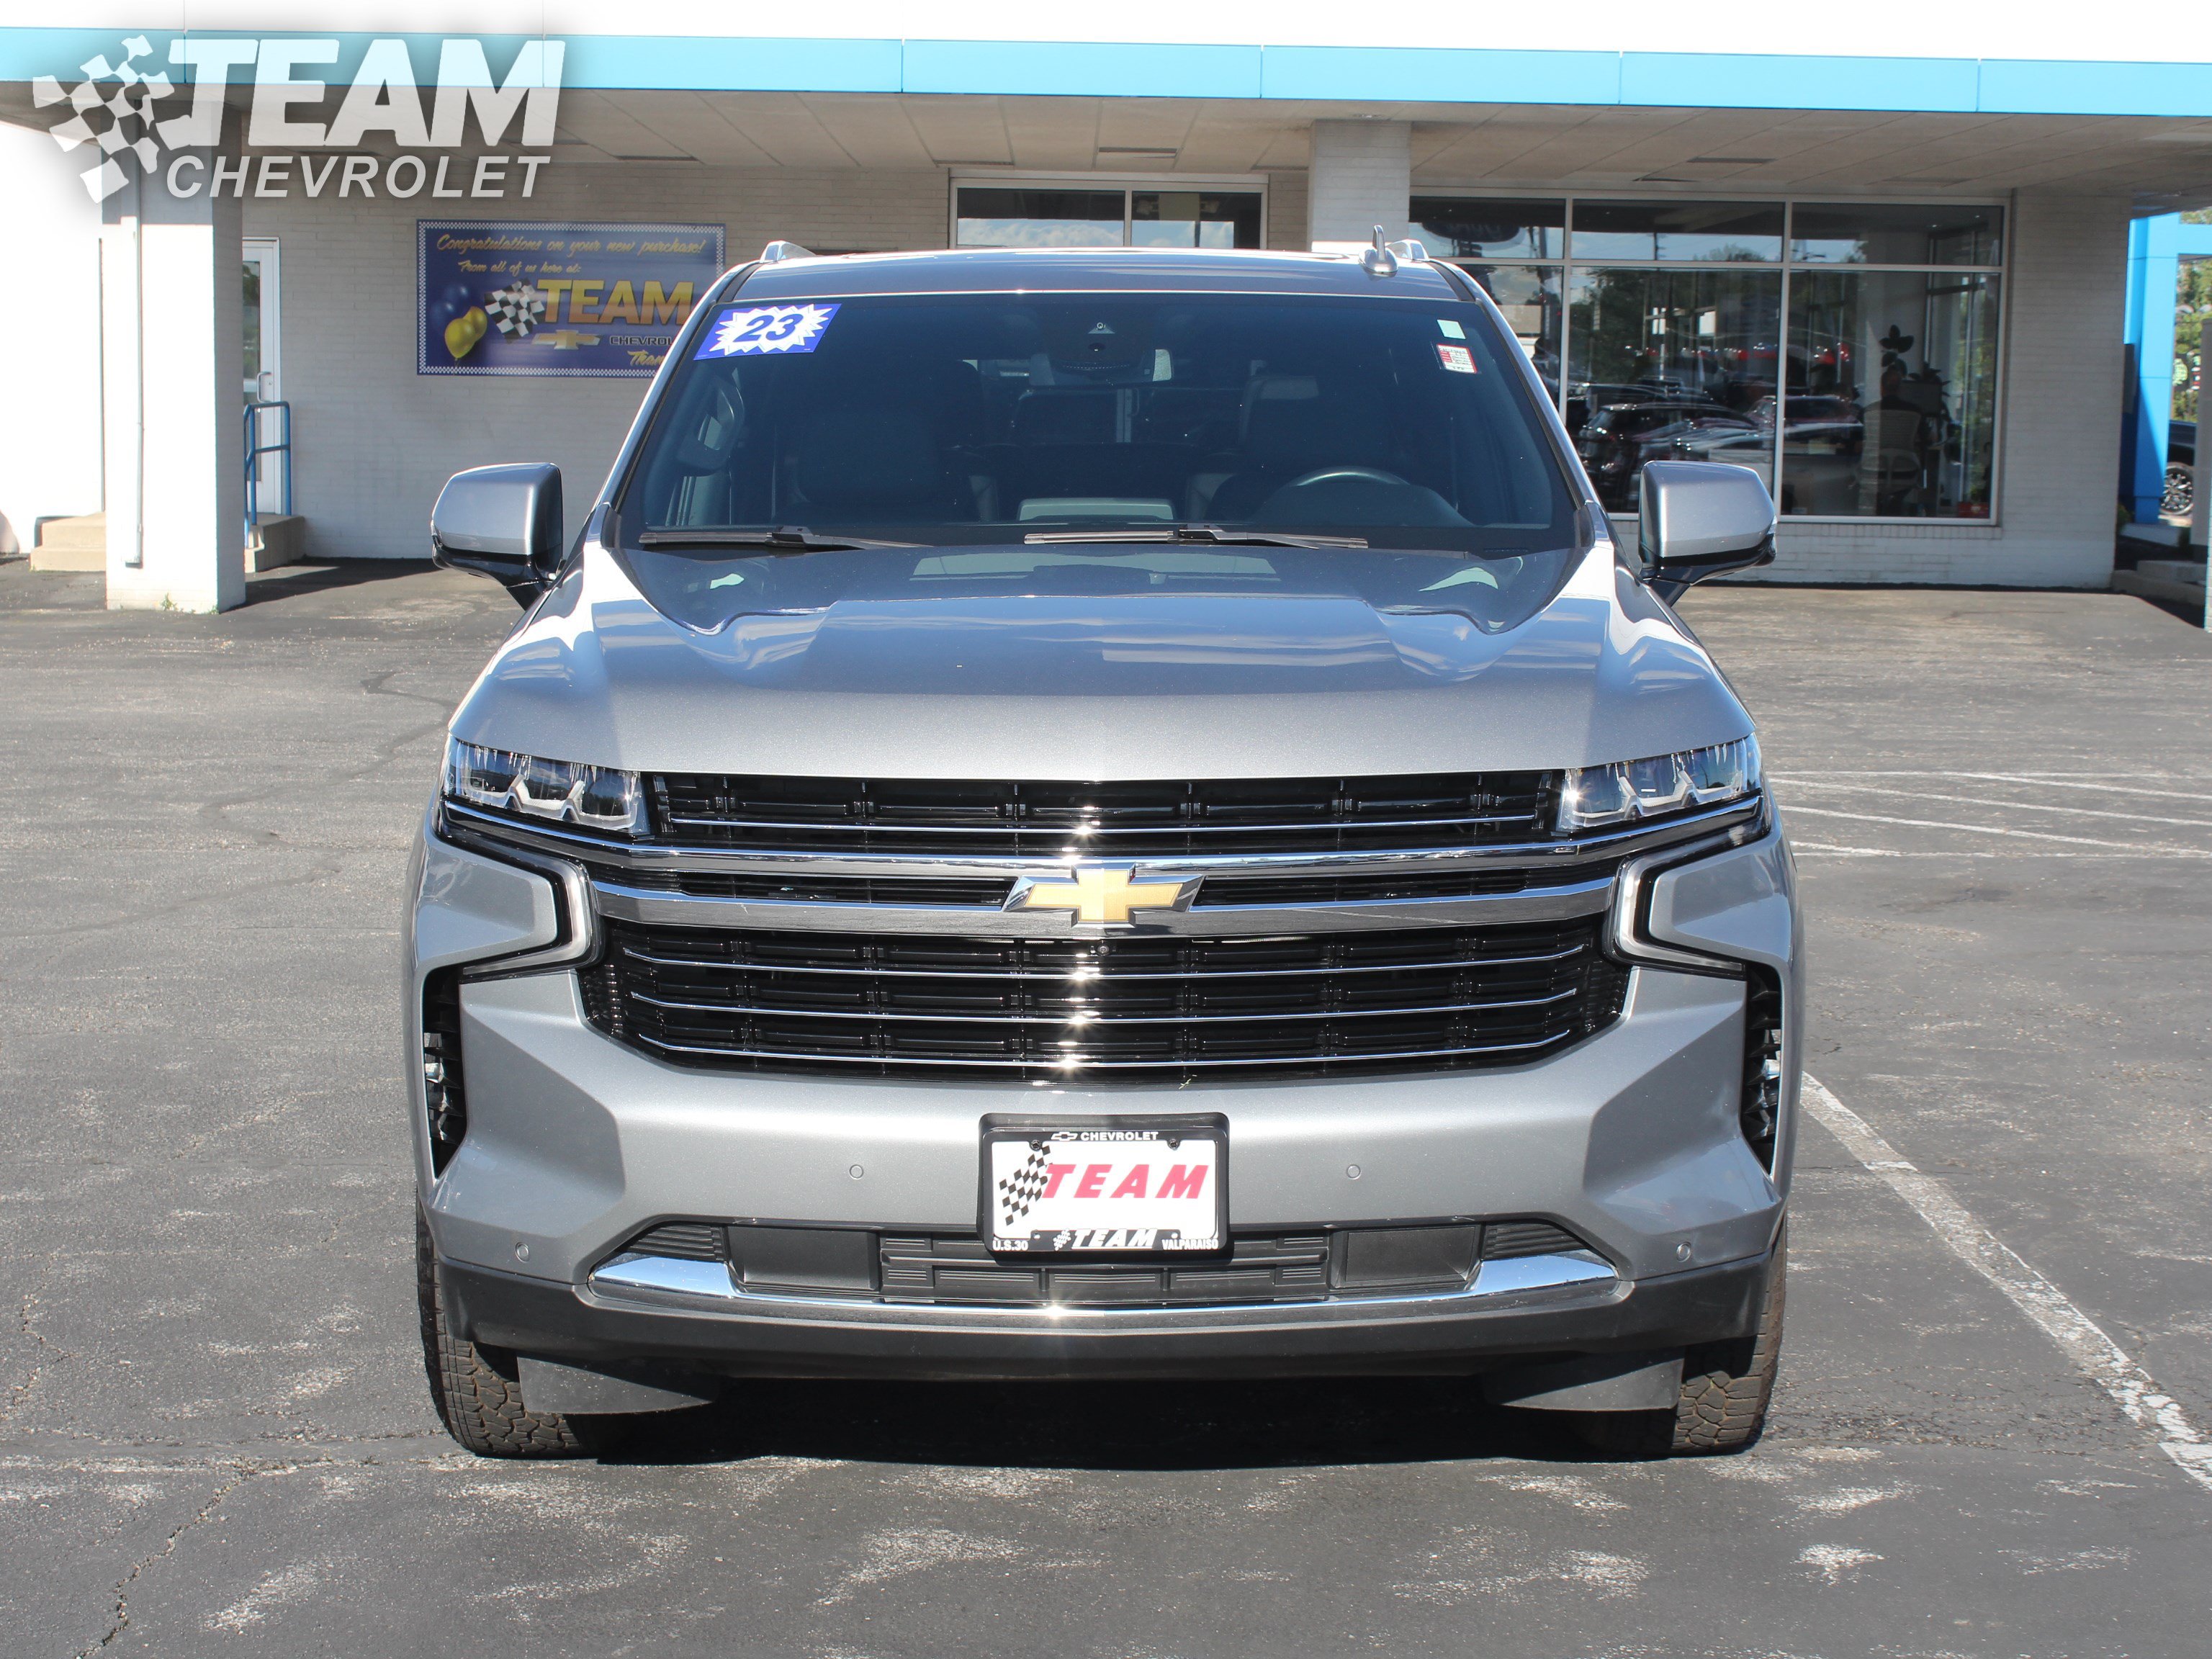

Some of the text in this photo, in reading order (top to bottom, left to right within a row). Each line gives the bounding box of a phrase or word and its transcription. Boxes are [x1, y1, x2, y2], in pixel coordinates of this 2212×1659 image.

[436, 234, 706, 257] Congratulations on your new purchase!
[458, 260, 487, 272] From
[490, 261, 507, 272] all
[509, 261, 522, 276] of
[540, 262, 563, 273] here
[537, 279, 694, 325] TEAM
[732, 313, 804, 343] 23
[1080, 1131, 1159, 1141] CHEVROLET
[1041, 1164, 1209, 1199] TEAM
[1071, 1228, 1158, 1246] TEAM
[1161, 1238, 1219, 1250] VALPARAISO
